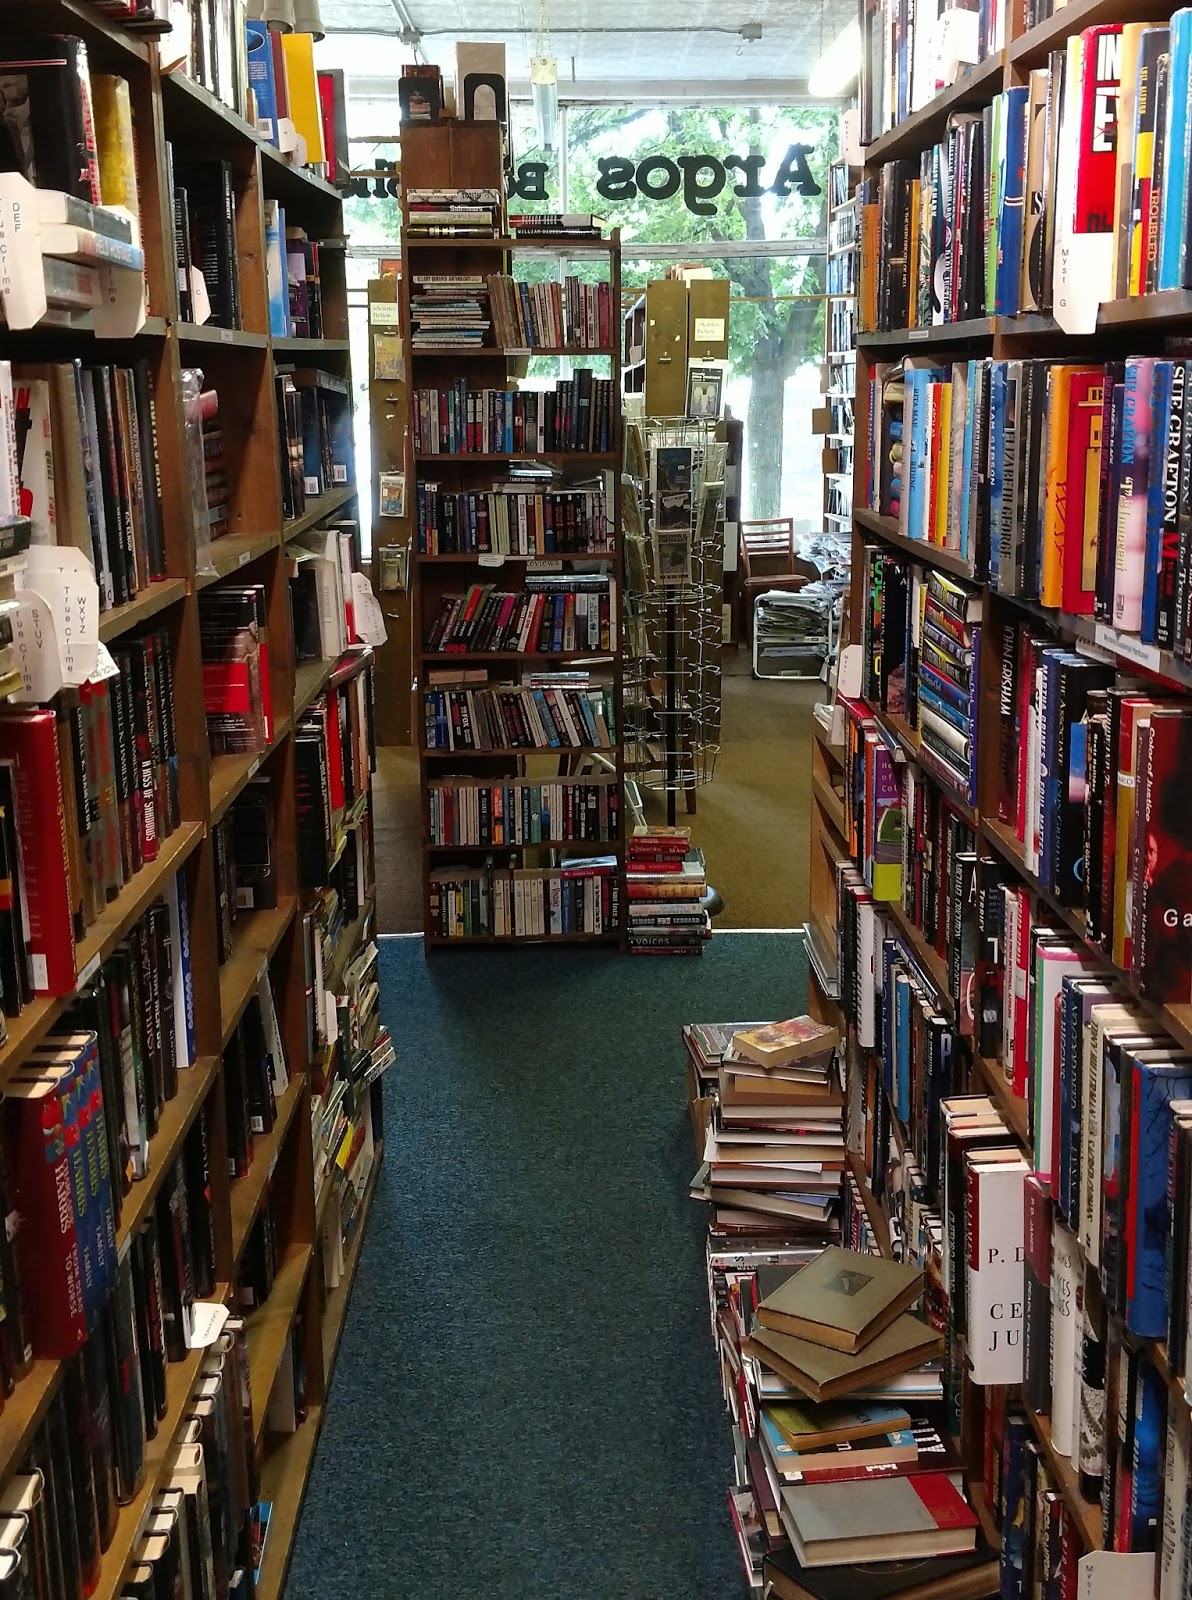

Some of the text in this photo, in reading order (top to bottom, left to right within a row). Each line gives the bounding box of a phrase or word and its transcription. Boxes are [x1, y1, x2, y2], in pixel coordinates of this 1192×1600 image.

[1148, 188, 1160, 262] TROUBLED
[1060, 249, 1069, 307] Myst G
[1126, 366, 1138, 393] SUE
[132, 413, 143, 500] OWEN BROOKES
[1122, 397, 1136, 465] GRAFTON
[1163, 366, 1184, 524] SUE GRAFTON
[1181, 411, 1191, 503] GRAFTON
[1000, 430, 1015, 561] ELIZABETH GEORGE
[1116, 510, 1130, 574] Innocent
[1162, 533, 1179, 558] M
[1175, 570, 1186, 639] Trespass
[19, 643, 32, 691] Crime
[65, 628, 74, 672] Crime
[1000, 625, 1014, 716] JOHN GRISHAM
[1041, 664, 1049, 711] MARTHA
[131, 734, 139, 790] HAMILTON
[1057, 700, 1067, 767] ASSOCIATE
[1147, 727, 1156, 760] Color
[77, 707, 91, 830] LAURELL HAMILTON
[119, 744, 129, 798] HAMILTON
[142, 768, 153, 788] KISS
[143, 790, 153, 799] OF
[1147, 762, 1154, 775] of
[144, 803, 156, 842] SHADOWS
[1144, 777, 1154, 823] Justice
[1139, 917, 1147, 968] Hardwick
[1163, 909, 1192, 926] Ga
[1069, 1004, 1079, 1109] NO GOOD DEED
[1089, 1022, 1098, 1050] TONY
[1088, 1052, 1098, 1119] HILLERMAN
[54, 1163, 70, 1235] HARRIS
[84, 1130, 105, 1266] HARRIS FAMILY
[95, 1114, 114, 1249] HARRIS FAMILY
[72, 1150, 93, 1288] HARRIS FAMILY
[71, 1243, 84, 1314] FROM DEAD
[988, 1248, 1004, 1264] P.
[63, 1252, 76, 1319] TO WORSE
[990, 1303, 1023, 1320] CE
[989, 1331, 1020, 1352] JU
